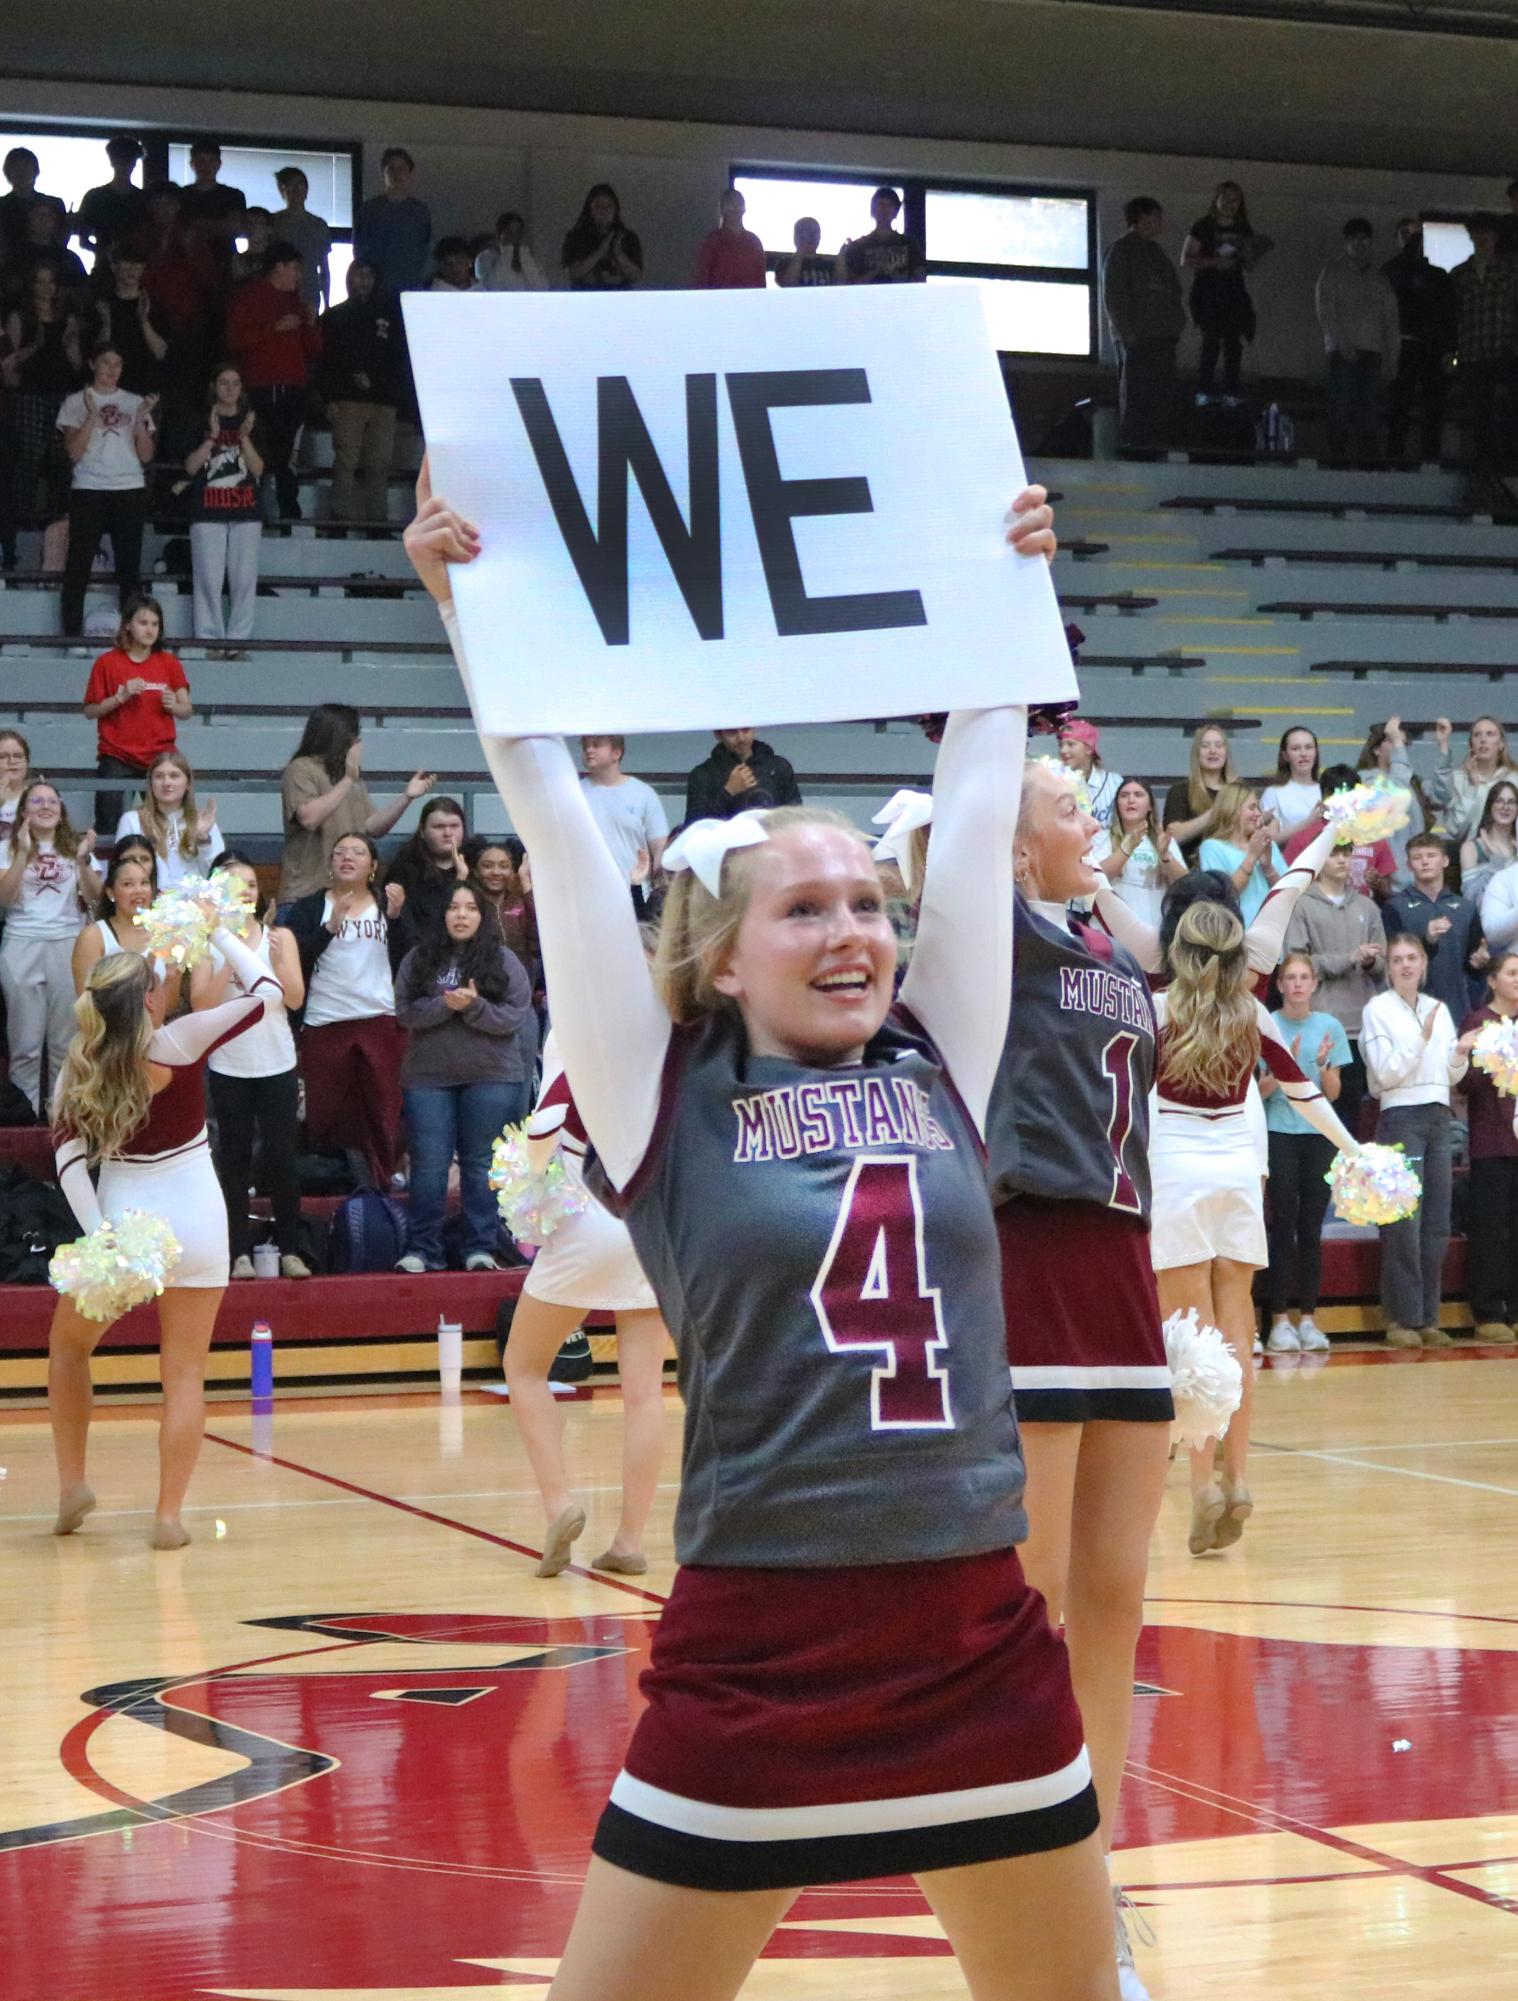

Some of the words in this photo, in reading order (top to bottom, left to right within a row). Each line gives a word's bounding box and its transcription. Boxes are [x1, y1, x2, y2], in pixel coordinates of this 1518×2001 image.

[509, 368, 928, 645] WE
[1102, 1030, 1142, 1214] 1
[812, 1154, 956, 1431] 4
